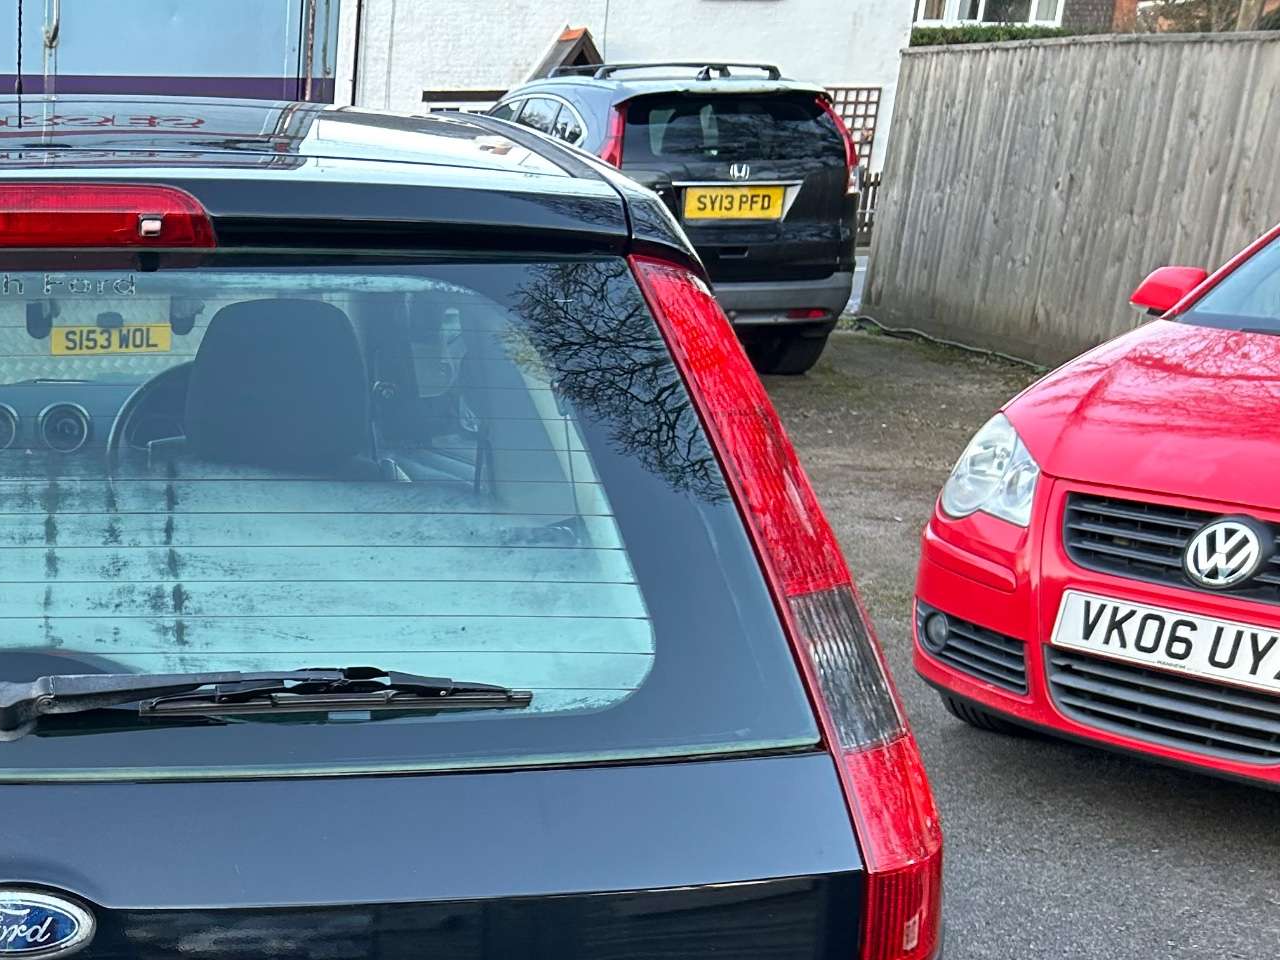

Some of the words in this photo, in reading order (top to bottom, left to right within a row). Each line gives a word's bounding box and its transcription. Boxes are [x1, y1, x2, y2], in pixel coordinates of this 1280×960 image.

[697, 194, 734, 211] SY13
[739, 194, 771, 211] PFD
[43, 274, 136, 296] Ford
[64, 328, 112, 351] S153
[118, 327, 159, 350] WOL
[1082, 600, 1198, 661] VK06
[1207, 625, 1280, 681] UY
